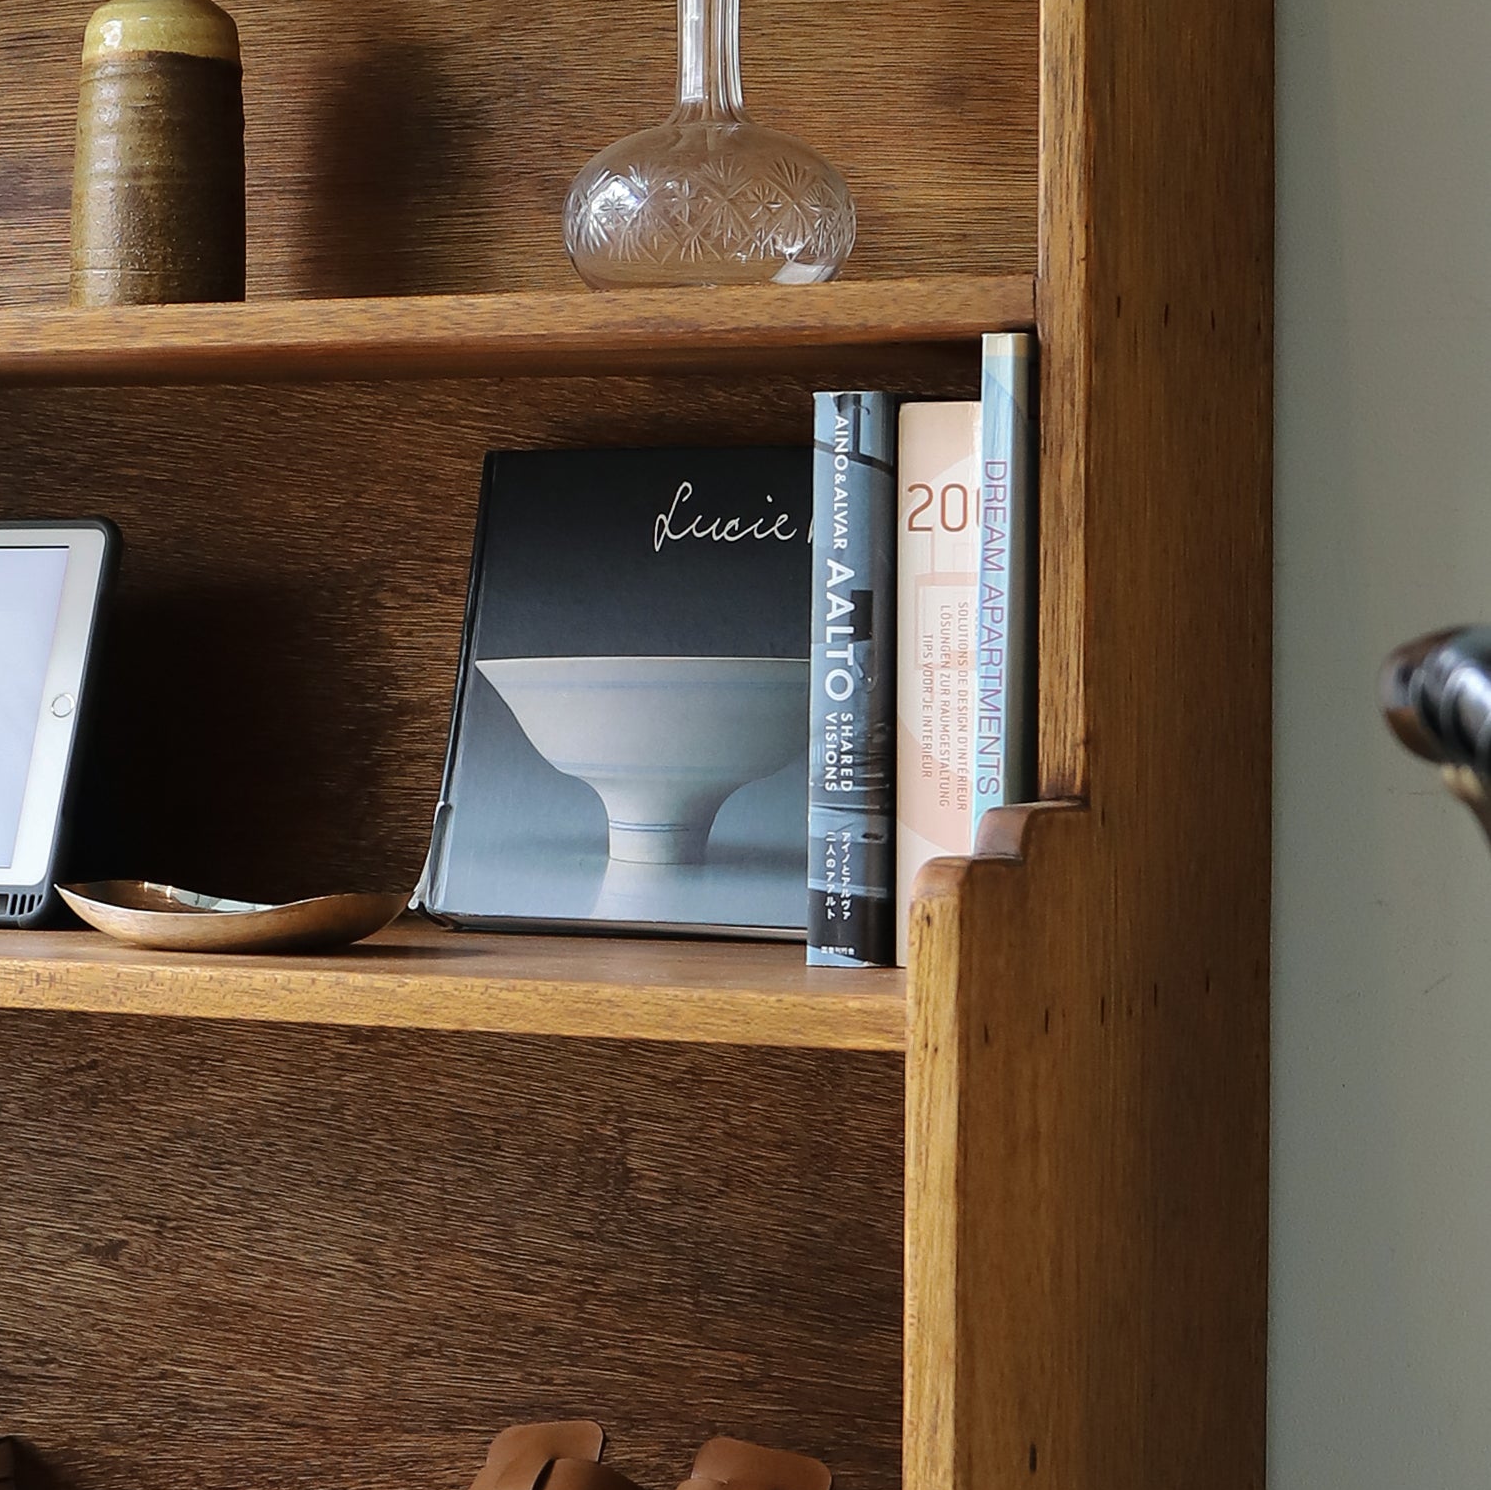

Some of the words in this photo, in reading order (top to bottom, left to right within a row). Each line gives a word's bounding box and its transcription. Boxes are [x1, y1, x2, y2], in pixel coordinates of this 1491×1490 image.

[654, 481, 798, 552] Lucie
[833, 415, 850, 551] AINO&ALVAR
[907, 482, 981, 533] 20
[985, 459, 1007, 572] DREAM
[824, 558, 856, 702] AALTO
[922, 633, 933, 659] TIPS
[940, 604, 952, 669] LÖSUNGEN
[957, 601, 969, 666] SOLUTIONS
[922, 662, 933, 694] VOOR
[922, 697, 933, 711] JE
[940, 673, 950, 696] ZUR
[957, 669, 968, 685] DE
[957, 689, 968, 733] DESIGN
[976, 581, 1006, 796] APARTMENTS
[824, 711, 837, 792] VISIONS
[840, 712, 854, 793] SHARED
[921, 715, 933, 778] INTERIEUR
[939, 699, 950, 807] RAUMGESTALTUNG
[825, 831, 837, 920] 二人のアアルト
[840, 831, 851, 921] アイノとアルヴァ
